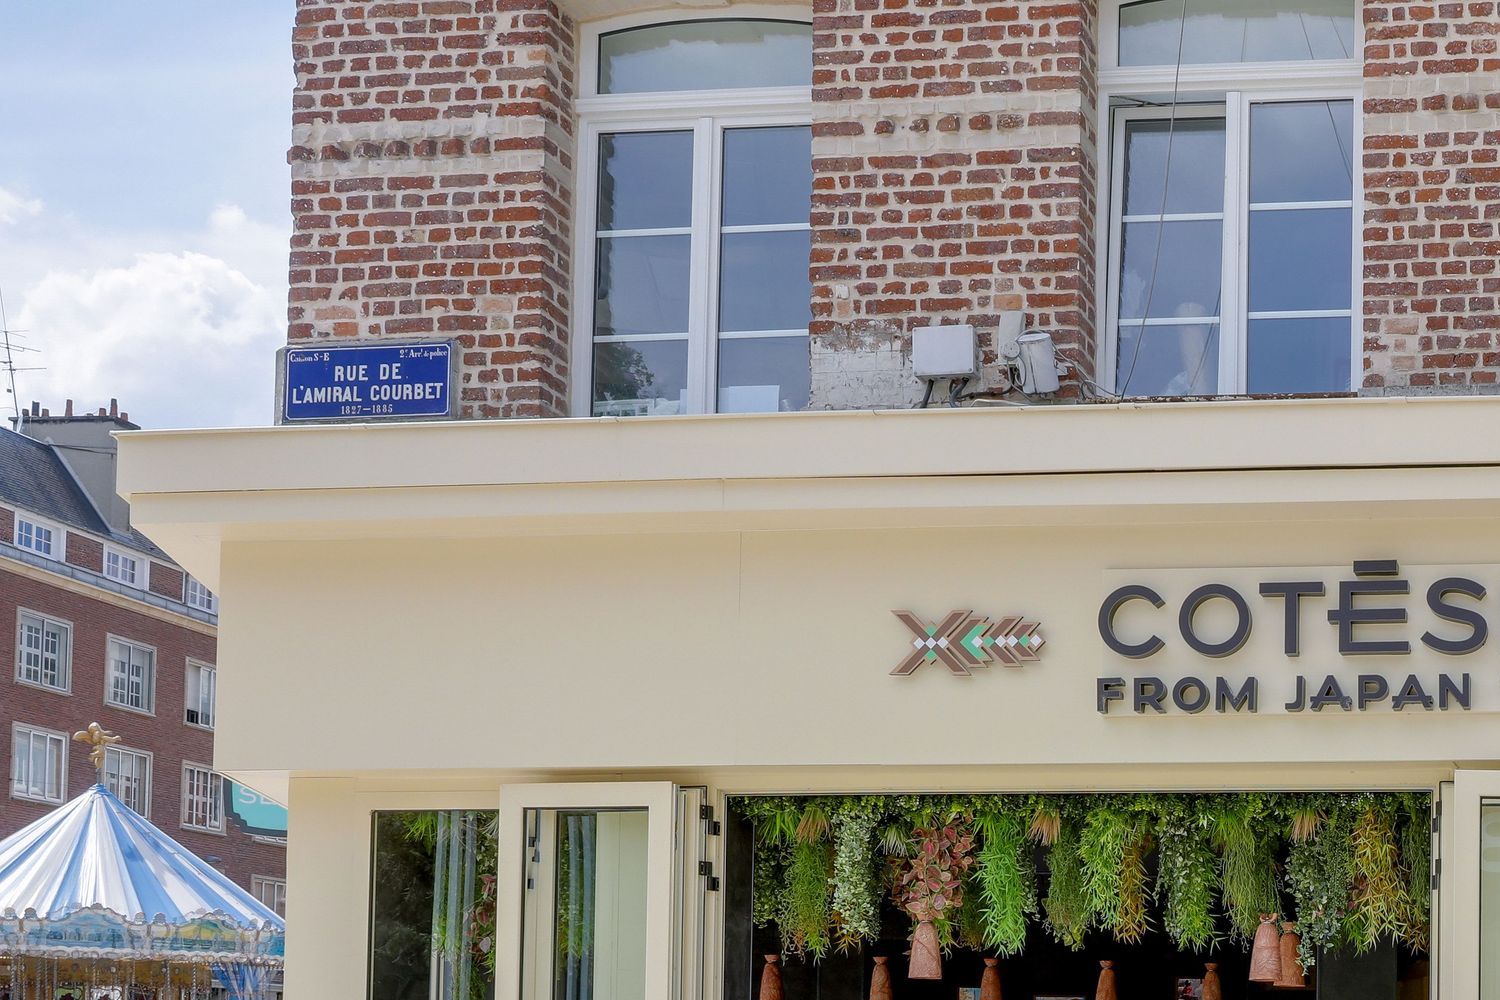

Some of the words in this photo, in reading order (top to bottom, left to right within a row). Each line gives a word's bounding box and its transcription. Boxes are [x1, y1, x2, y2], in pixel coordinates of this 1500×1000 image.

[430, 348, 447, 360] police
[334, 365, 368, 381] RUE
[380, 363, 402, 380] DE
[292, 385, 362, 404] L'AMIRAL
[370, 383, 443, 401] COURBET
[1097, 676, 1258, 714] FROM
[1284, 673, 1471, 712] JAPAN
